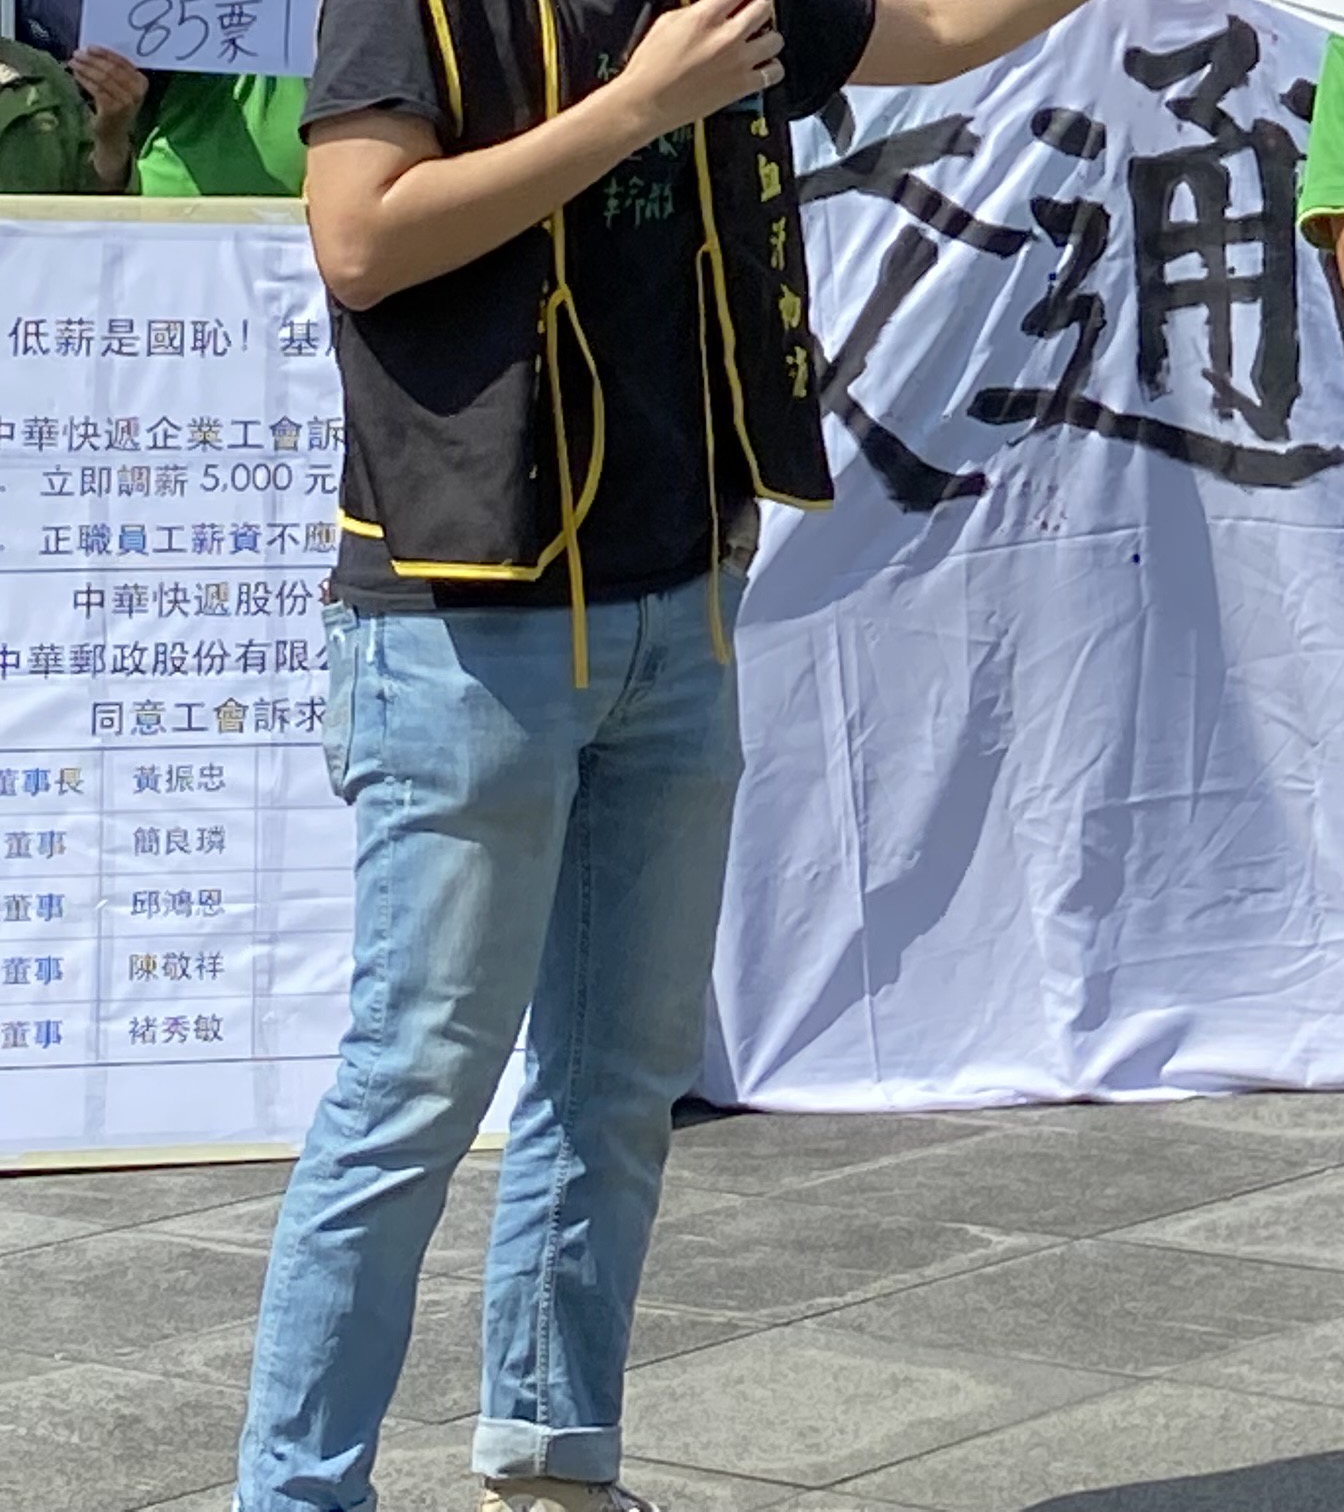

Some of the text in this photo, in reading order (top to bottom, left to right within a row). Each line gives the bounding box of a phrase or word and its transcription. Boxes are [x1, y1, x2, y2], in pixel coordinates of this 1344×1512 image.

[8, 316, 336, 358] 低薪是國恥！ 基
[40, 463, 338, 498] 立即調薪 5,000 元
[91, 696, 326, 736] 同意工會訴求
[133, 762, 227, 795] 黃振忠
[4, 829, 67, 860] 董事
[3, 892, 65, 922] 董事
[2, 950, 225, 986] 董事 陳敬祥
[1, 1018, 63, 1049] 董事
